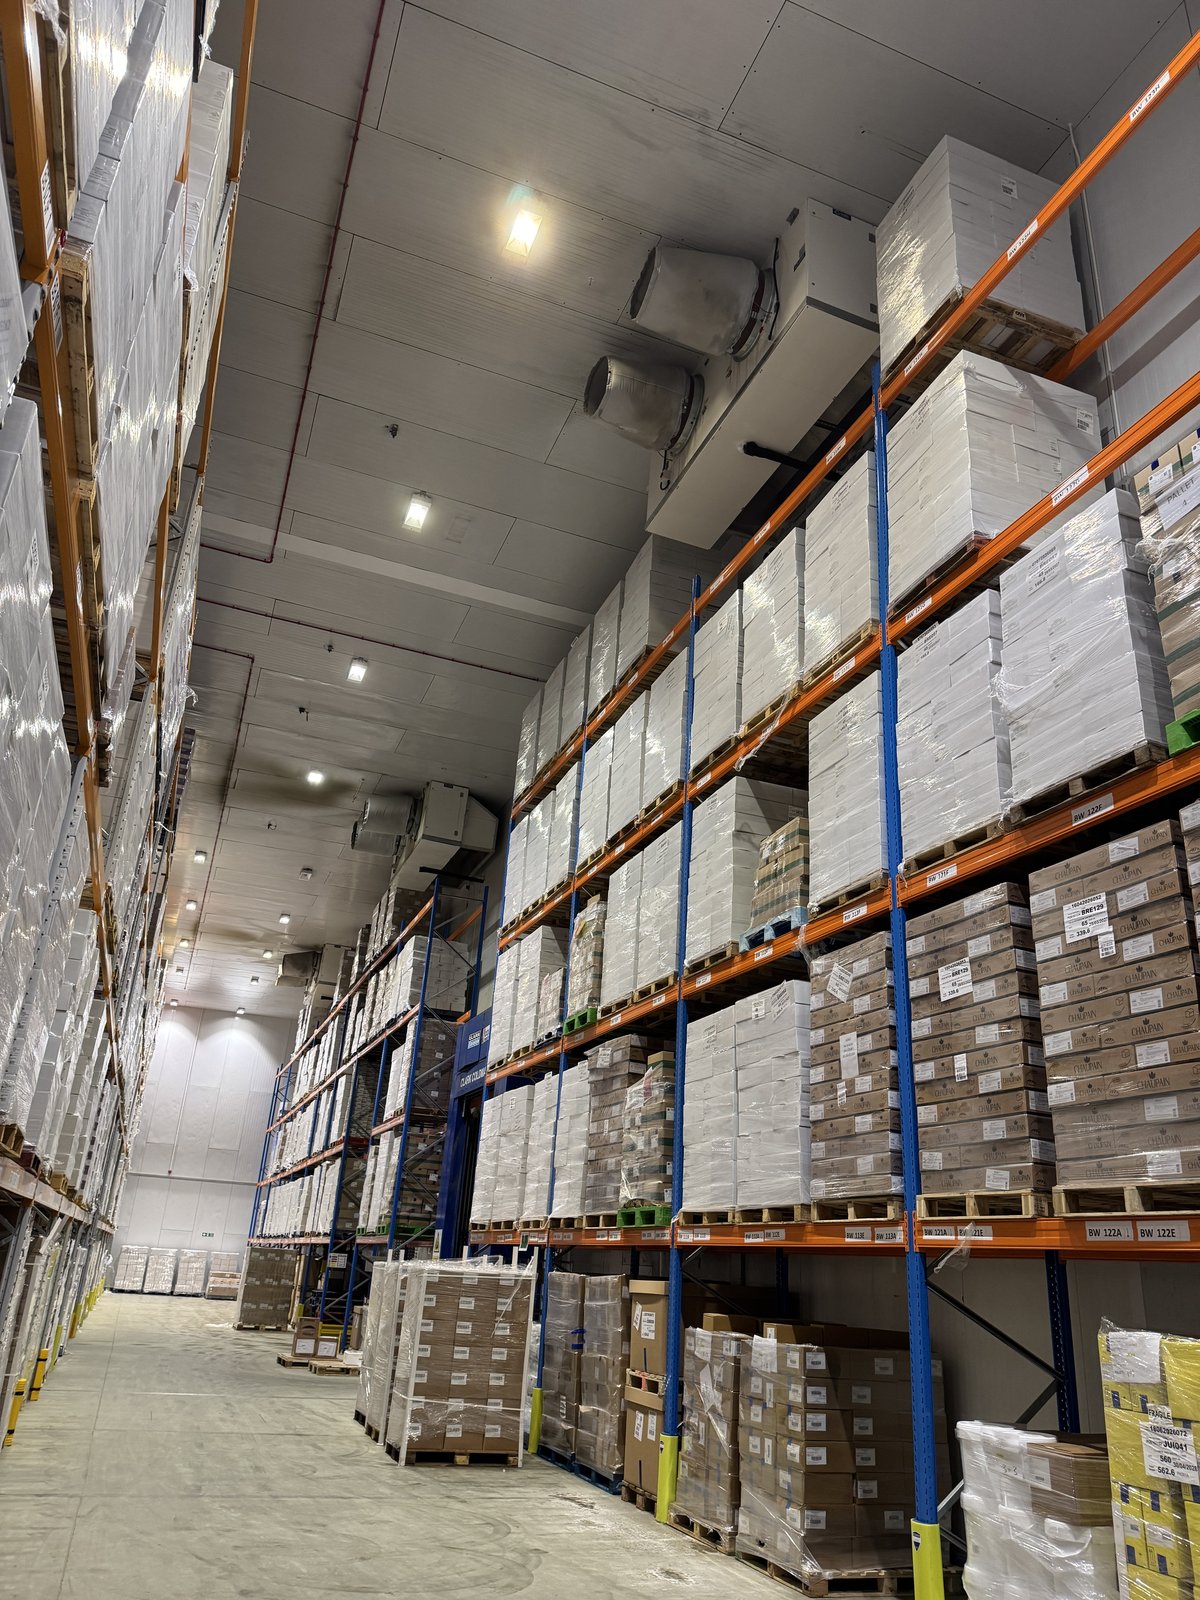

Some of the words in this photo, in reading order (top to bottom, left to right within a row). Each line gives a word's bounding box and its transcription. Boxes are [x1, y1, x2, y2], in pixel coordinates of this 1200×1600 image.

[1131, 103, 1143, 118] BW
[1167, 476, 1196, 504] PALLET
[1073, 810, 1086, 822] BW
[928, 875, 937, 883] BW
[1112, 867, 1142, 884] CHAUPAIN
[1150, 882, 1176, 895] CHAUPAIN
[1081, 903, 1104, 916] BRE129
[1119, 917, 1151, 934] CHAUPAIN
[1158, 933, 1185, 946] CHAUPAIN
[951, 966, 969, 978] BRE129
[1124, 969, 1157, 984] CHAUPAIN
[1166, 987, 1194, 1000] CHAUPAIN
[1068, 1010, 1097, 1023] CHAUPAIN
[1131, 1023, 1164, 1037] CHAUPAIN
[1073, 1060, 1103, 1073] CHAUPAIN
[885, 1232, 897, 1240] 113A
[924, 1228, 933, 1236] BW
[934, 1228, 947, 1236] 121A
[1088, 1228, 1100, 1237] BW
[1103, 1228, 1122, 1237] 122A
[1140, 1228, 1153, 1238] BW
[1157, 1228, 1176, 1238] 122E
[1148, 1408, 1172, 1420] FRAGILE
[1159, 1455, 1172, 1464] 560
[1157, 1466, 1176, 1476] 562.6
